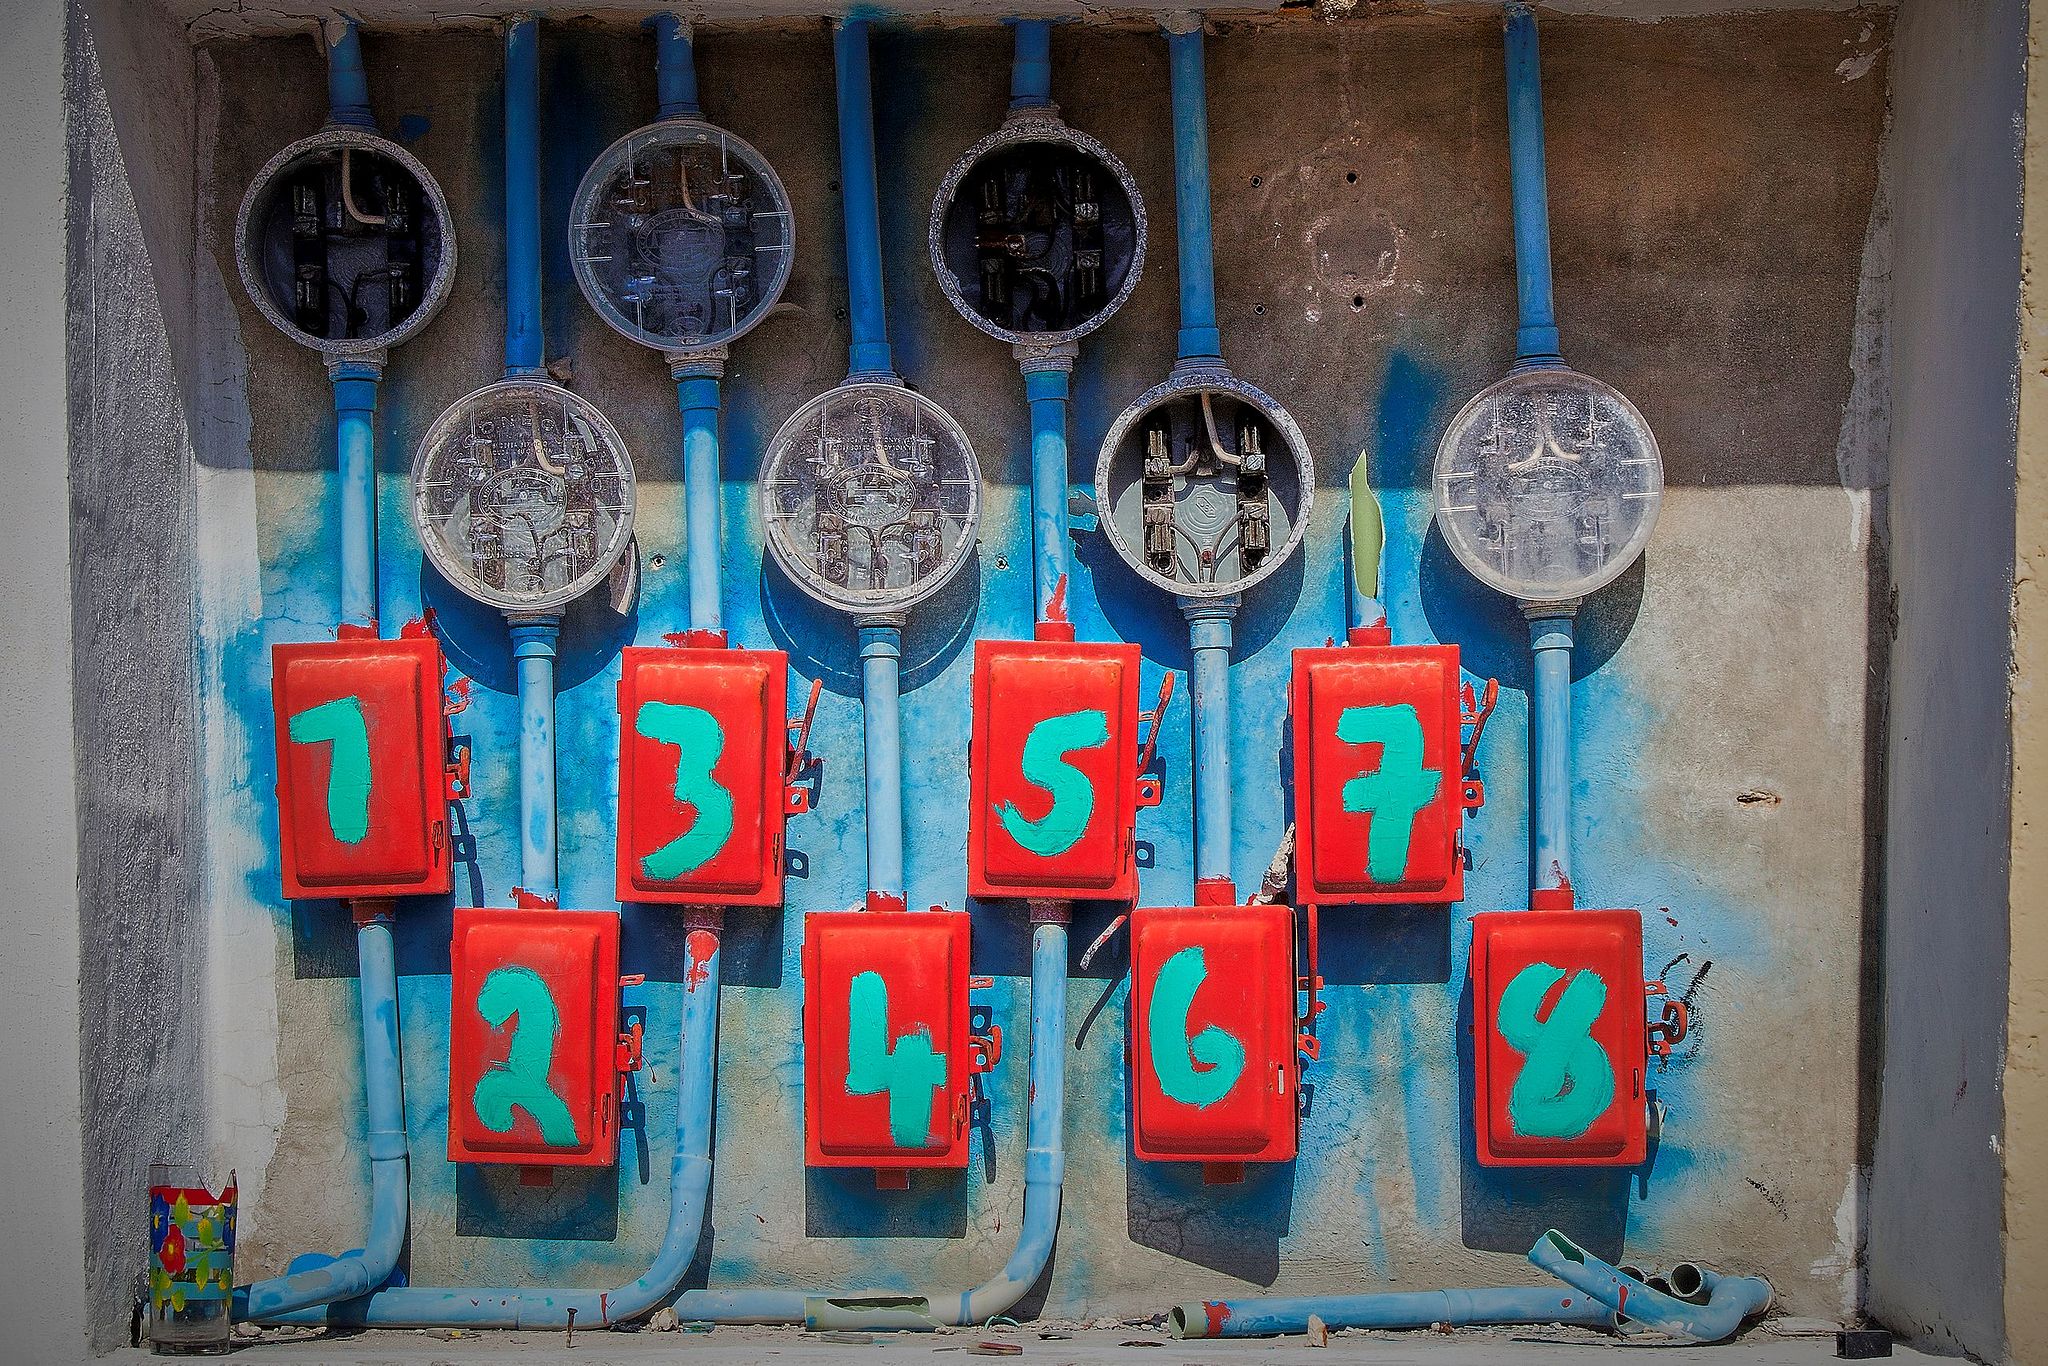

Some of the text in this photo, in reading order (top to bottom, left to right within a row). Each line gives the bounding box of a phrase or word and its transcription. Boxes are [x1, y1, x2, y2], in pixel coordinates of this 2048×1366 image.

[289, 696, 372, 844] 1
[636, 702, 734, 879] 3
[994, 710, 1109, 856] 5
[1335, 704, 1442, 882] 7
[474, 968, 579, 1146] 2
[845, 972, 947, 1147] 4
[1150, 946, 1244, 1107] 6
[1497, 962, 1616, 1138] 8
